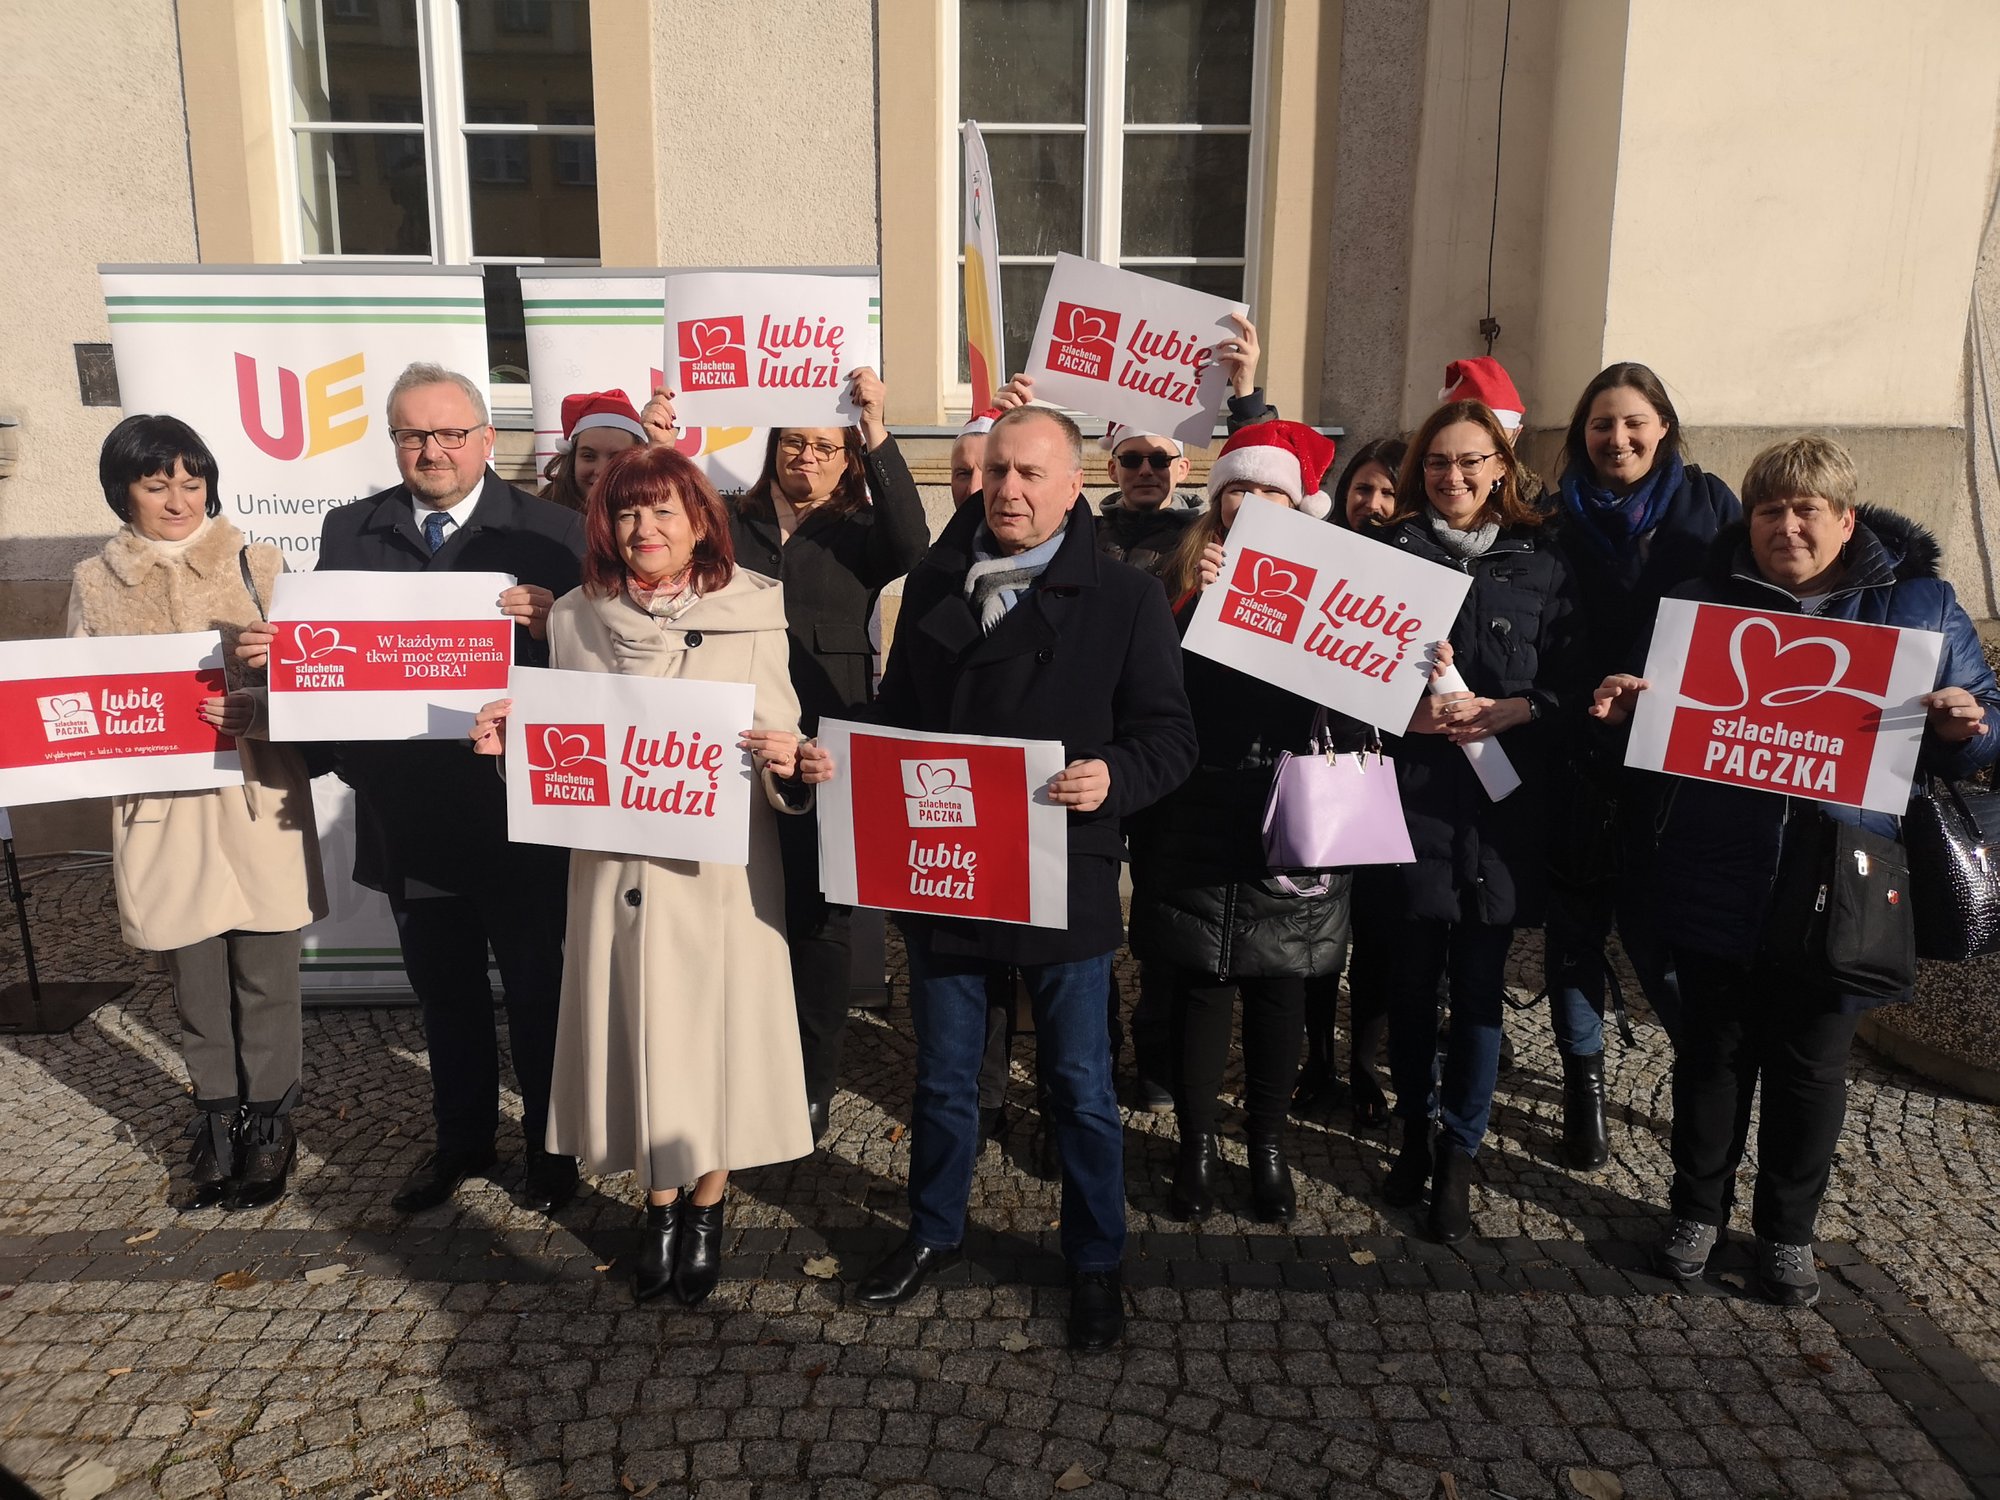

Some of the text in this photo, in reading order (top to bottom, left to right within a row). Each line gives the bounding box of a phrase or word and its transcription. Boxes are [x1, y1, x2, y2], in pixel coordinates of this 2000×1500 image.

[757, 314, 845, 359] Lubię
[1126, 319, 1212, 378] Lubię
[692, 360, 735, 371] szlachetna
[1057, 353, 1099, 376] PACZKA
[1061, 344, 1101, 363] szlachetna
[692, 371, 736, 385] PACZKA
[758, 357, 840, 388] ludzi
[1118, 360, 1201, 406] ludzi
[234, 351, 369, 461] UE
[1233, 605, 1283, 636] PACZKA
[1240, 597, 1288, 622] szlachetna
[1319, 578, 1422, 651] Lubię
[377, 633, 494, 650] W każdym z nas
[1303, 622, 1404, 683] ludzi
[296, 663, 345, 674] szlachetna
[366, 648, 504, 666] tkwi moc czynienia
[296, 674, 345, 688] PACZKA
[404, 664, 467, 678] DOBRA!
[101, 687, 165, 717] Lubię
[56, 726, 89, 736] PACZKA
[105, 713, 166, 735] ludzi
[1711, 715, 1845, 756] szlachetna
[97, 747, 113, 755] ludzi
[620, 725, 723, 781] Lubię
[1703, 740, 1837, 793] PACZKA
[544, 772, 594, 786] szlachetna
[545, 783, 595, 802] PACZKA
[621, 775, 718, 817] ludzi
[918, 799, 962, 810] szlachetna
[919, 809, 963, 823] PACZKA
[907, 839, 977, 876] Lubię
[909, 871, 975, 900] ludzi
